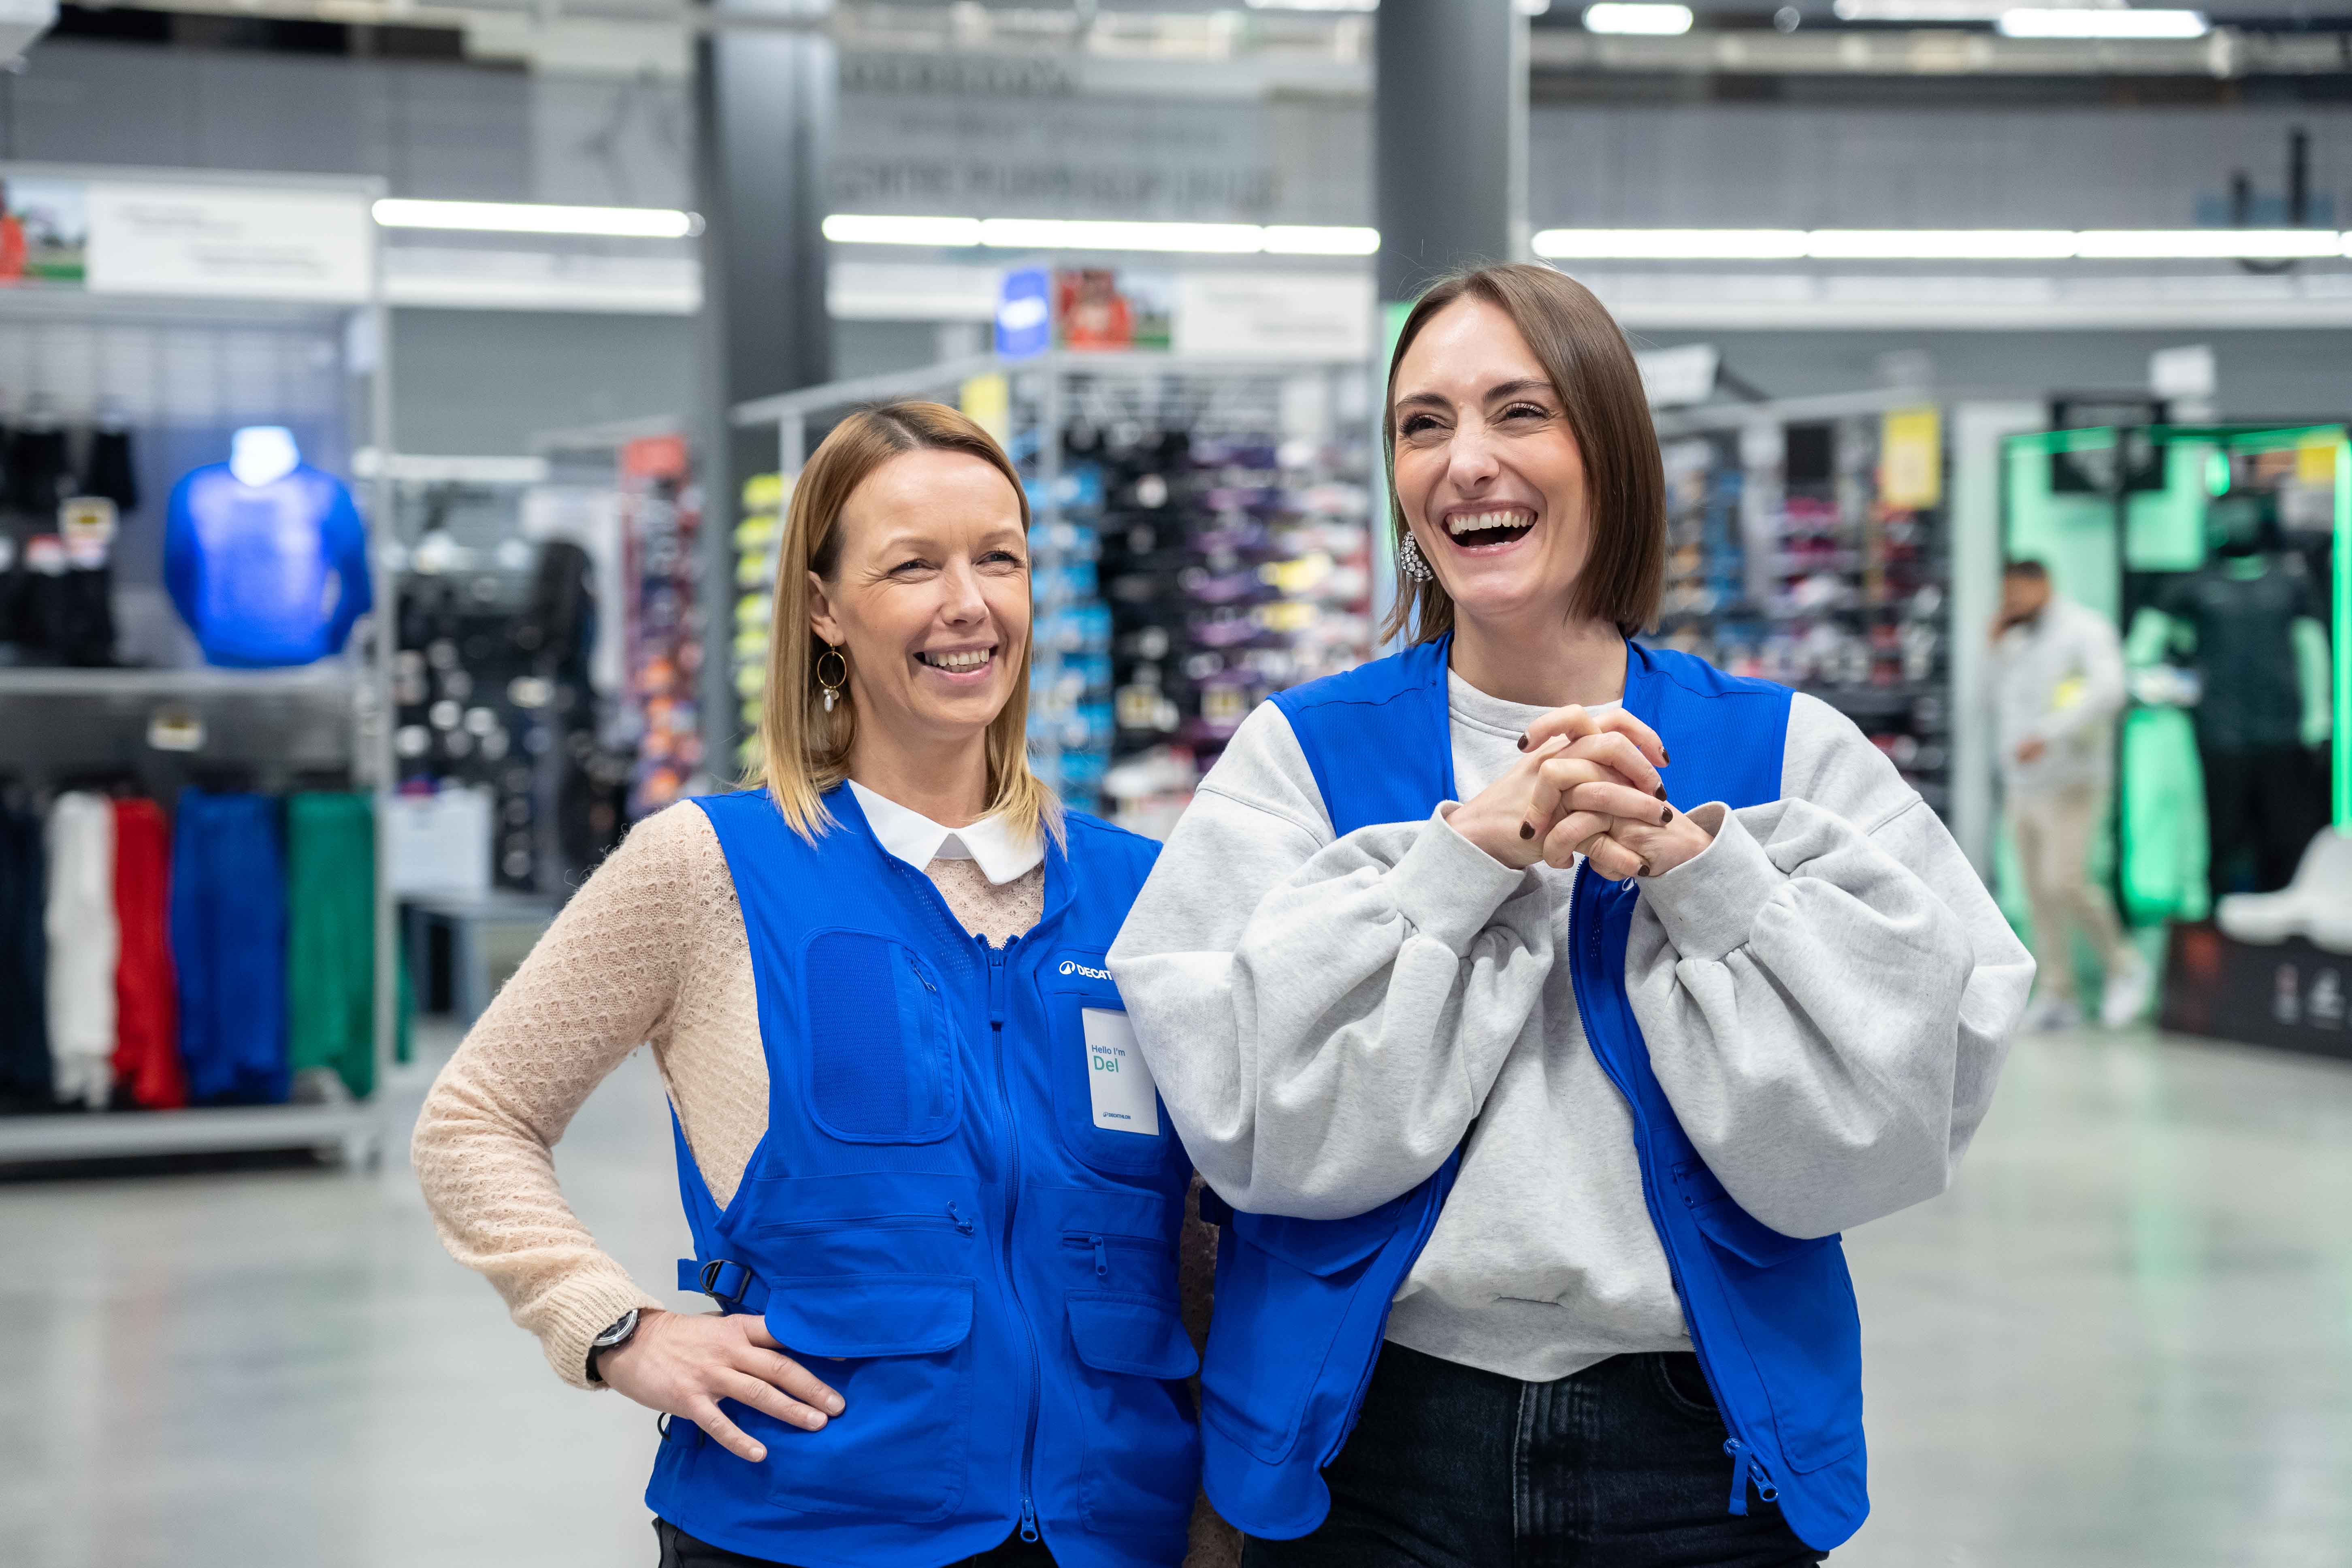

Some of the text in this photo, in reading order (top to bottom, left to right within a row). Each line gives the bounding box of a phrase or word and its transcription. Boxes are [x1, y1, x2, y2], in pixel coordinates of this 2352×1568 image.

[1076, 964, 1112, 980] DECAT
[1091, 1044, 1125, 1056] Hello I'm
[1093, 1055, 1119, 1073] Del
